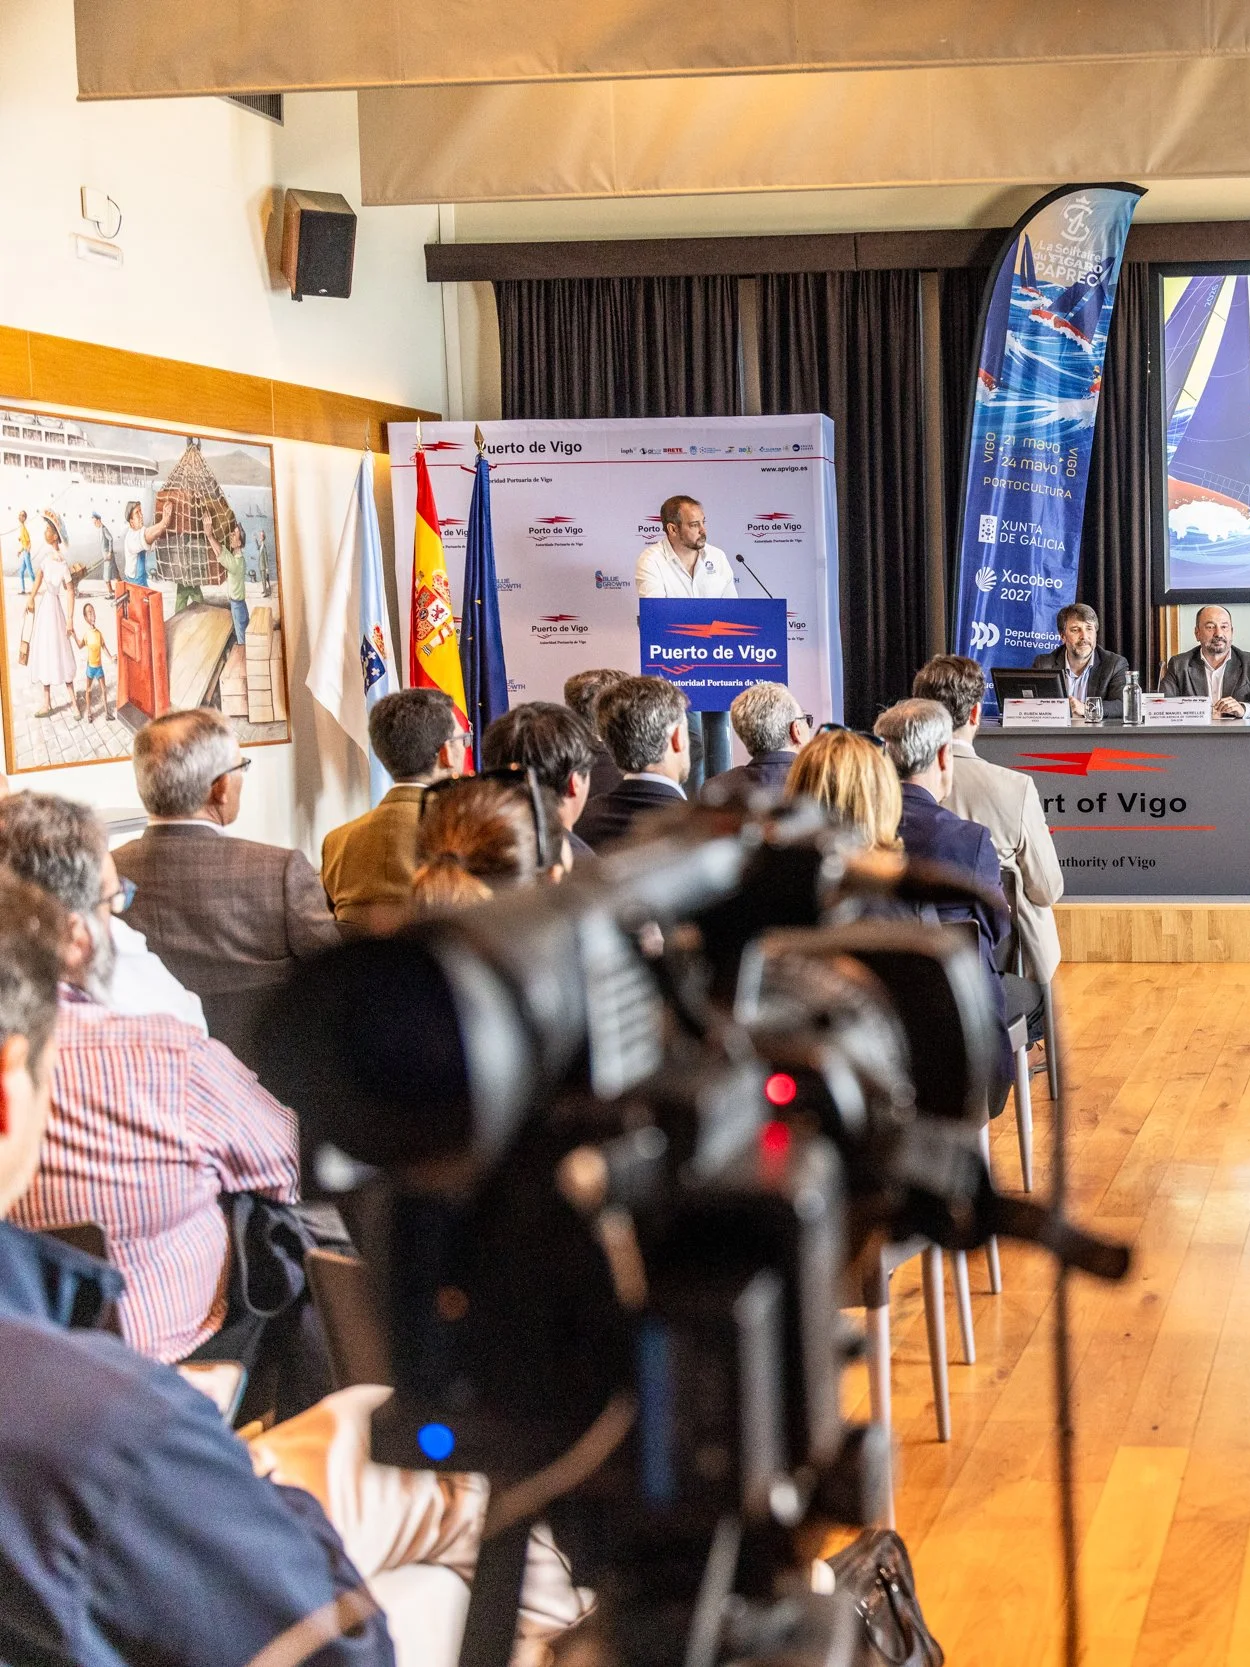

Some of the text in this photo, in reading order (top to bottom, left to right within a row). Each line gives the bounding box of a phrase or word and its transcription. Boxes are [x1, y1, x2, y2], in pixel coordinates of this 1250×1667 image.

[1039, 240, 1101, 263] La Solitaire
[1034, 251, 1103, 274] du FIGARO
[1035, 260, 1099, 287] PAPREC
[1004, 434, 1016, 446] 21
[529, 441, 546, 453] de
[549, 440, 583, 456] Vigo
[984, 432, 996, 463] VIGO
[760, 465, 808, 473] www.apvigo.es
[1001, 456, 1016, 468] 24
[1066, 447, 1079, 477] VIGO
[983, 476, 1072, 499] PORTOCULTURA
[456, 528, 469, 538] Vig
[553, 526, 563, 534] de
[564, 526, 583, 535] Vigo
[638, 525, 660, 533] Porto
[747, 523, 770, 531] Porto
[783, 522, 802, 532] Vigo
[1001, 520, 1043, 535] XUNTA
[999, 533, 1065, 551] DE GALICIA
[1001, 569, 1063, 589] Xacobeo
[1000, 588, 1032, 602] 2027
[531, 625, 557, 633] Puerto
[570, 624, 588, 634] Vigo
[788, 621, 806, 630] Vigo
[1005, 628, 1061, 642] Deputación
[650, 644, 777, 662] Puerto de Vigo
[707, 679, 743, 687] Portuaria
[1043, 792, 1187, 818] rt of Vigo
[1059, 856, 1156, 870] uthority of Vigo
